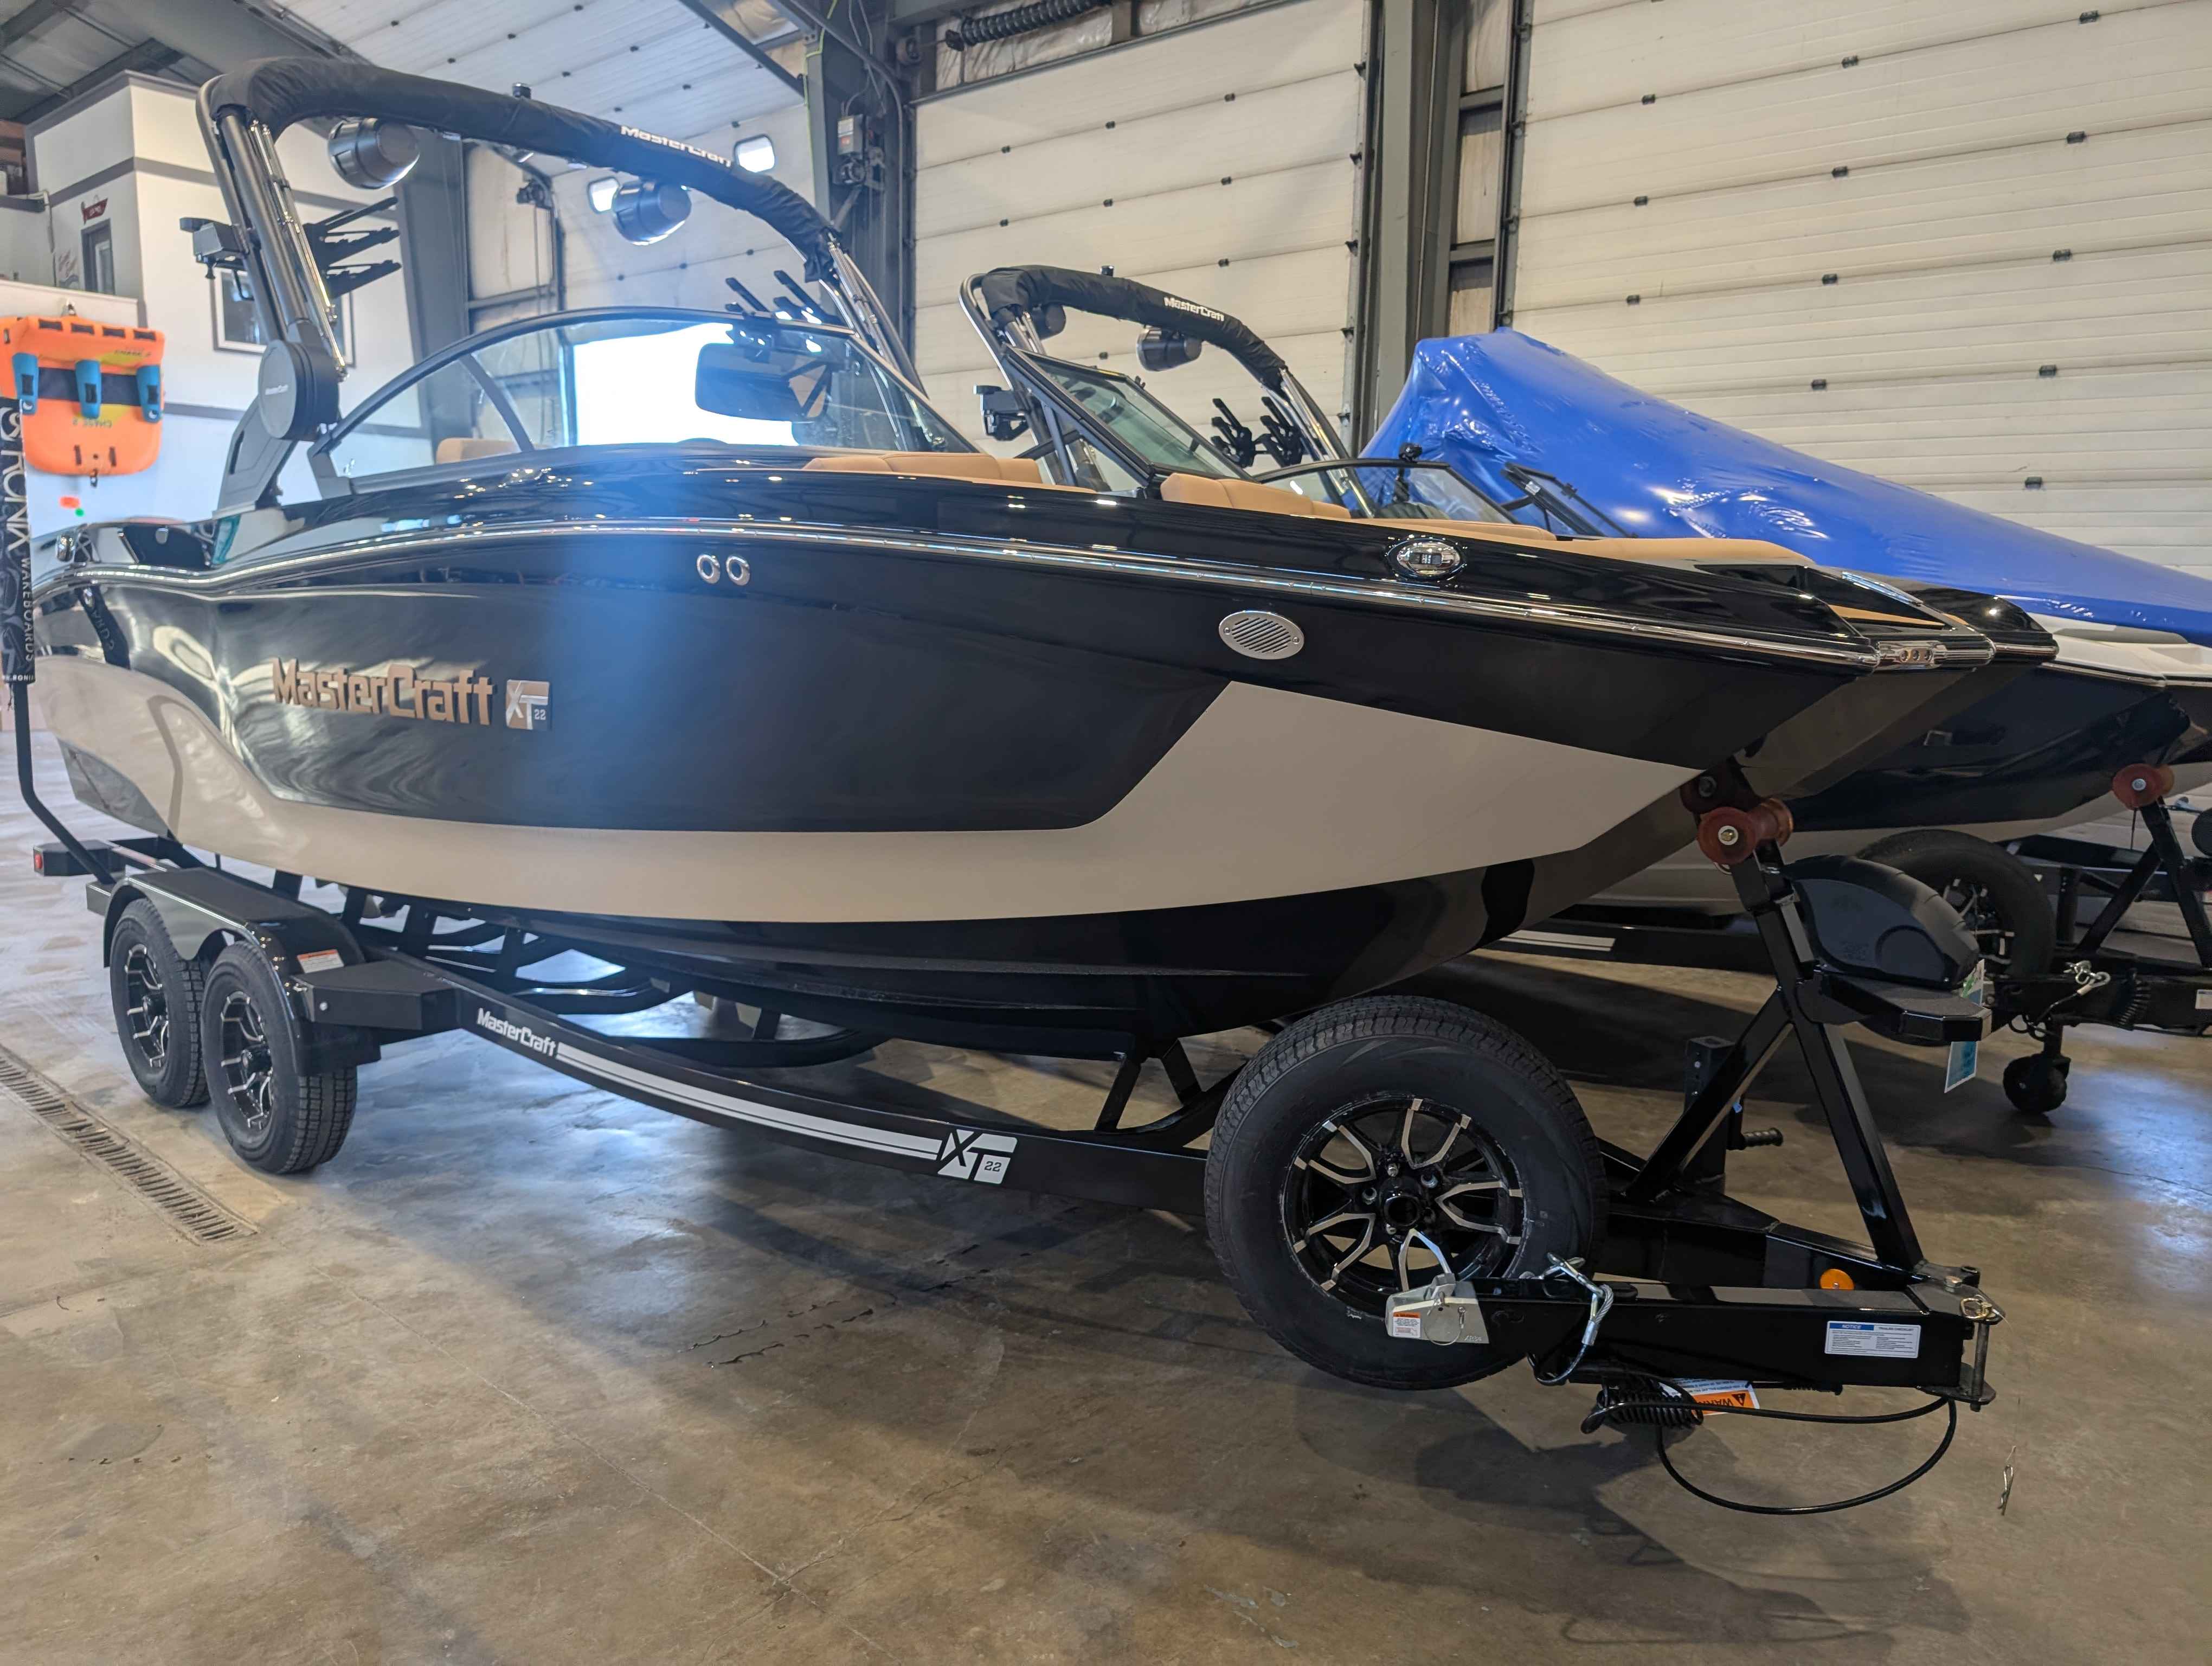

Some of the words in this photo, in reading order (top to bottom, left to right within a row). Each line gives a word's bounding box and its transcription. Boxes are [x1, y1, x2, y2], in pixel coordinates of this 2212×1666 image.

[21, 558, 35, 662] WAKEBOARDS
[272, 657, 494, 726] MasterCraft
[505, 679, 549, 730] XT
[534, 708, 546, 720] 22
[477, 1007, 556, 1056] MasterCraft
[937, 1129, 1018, 1185] XT
[983, 1161, 1002, 1172] 22
